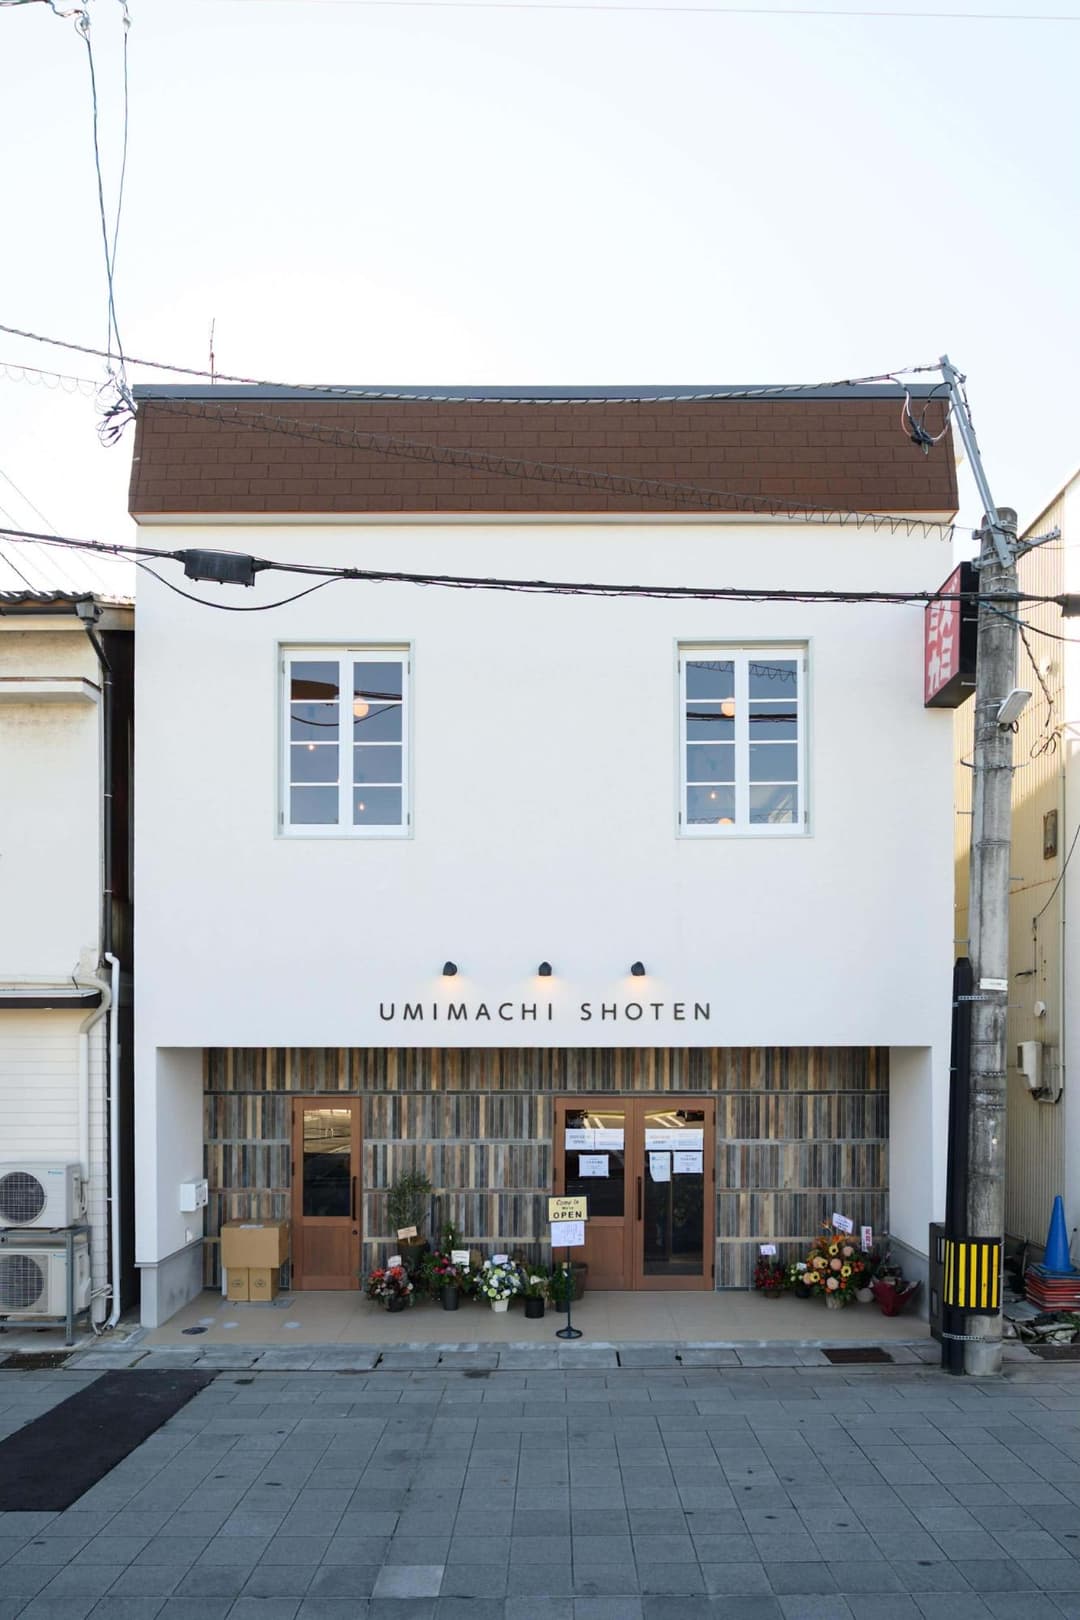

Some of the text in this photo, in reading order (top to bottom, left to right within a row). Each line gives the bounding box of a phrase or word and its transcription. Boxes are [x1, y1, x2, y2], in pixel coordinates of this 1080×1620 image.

[379, 1002, 711, 1021] UMIMACHI SHOTEN
[553, 1211, 582, 1219] OPEN
